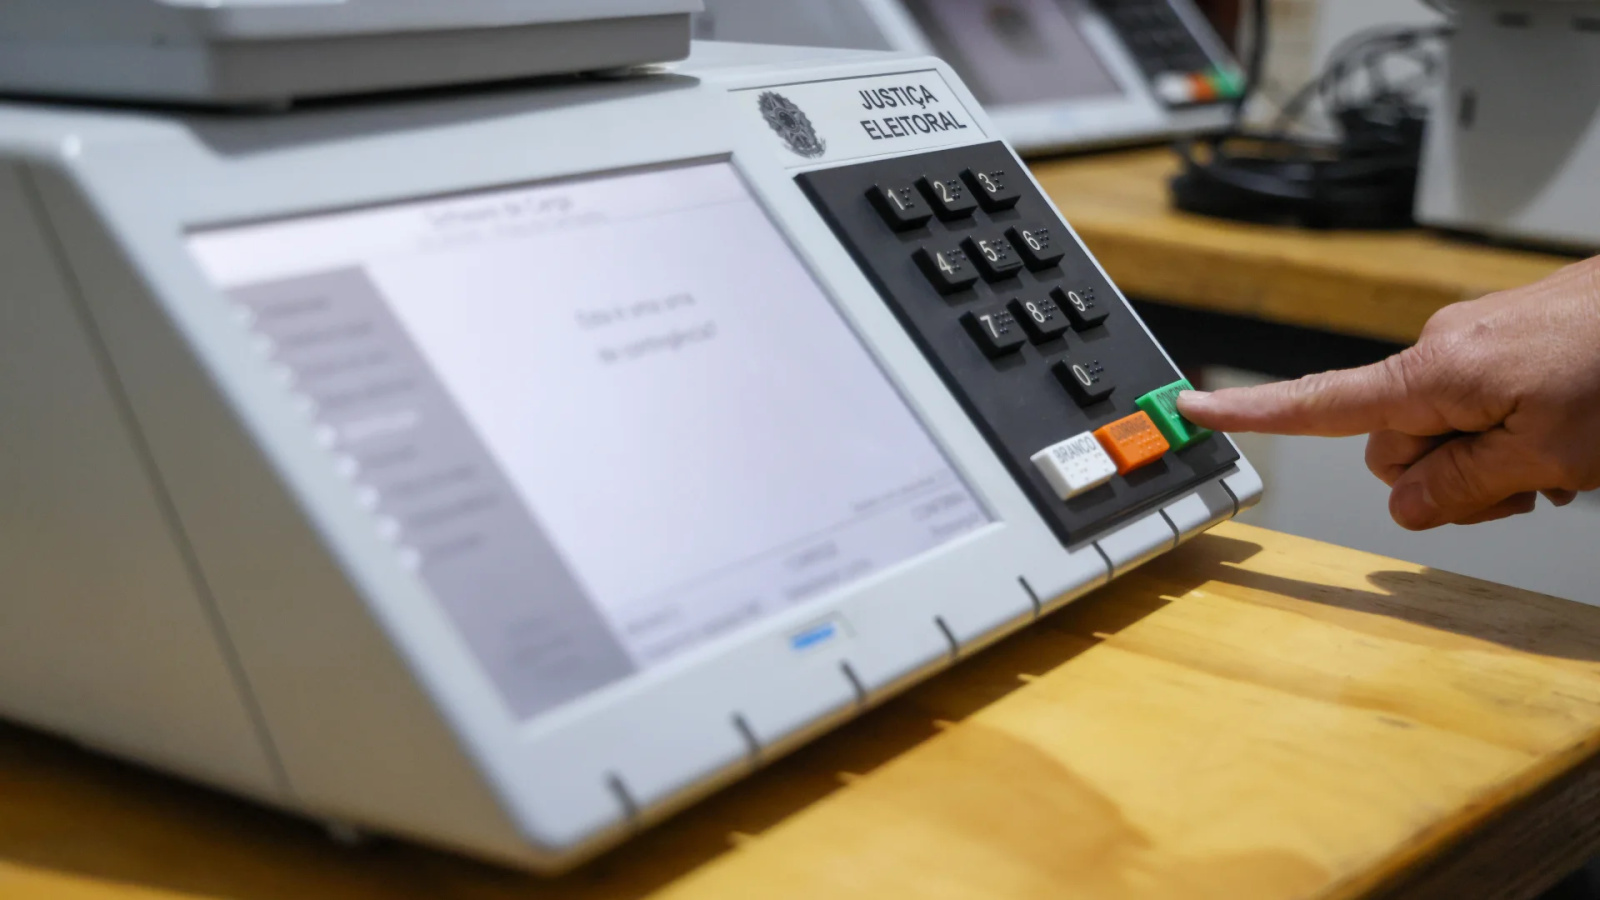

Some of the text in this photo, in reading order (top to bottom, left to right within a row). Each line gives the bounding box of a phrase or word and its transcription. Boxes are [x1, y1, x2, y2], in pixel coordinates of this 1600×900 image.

[858, 84, 939, 109] JUSTIÇA
[859, 110, 968, 140] ELEITORAL
[933, 181, 955, 203] 2
[977, 172, 997, 193] 3
[887, 188, 905, 211] 1
[978, 240, 998, 262] 5
[1022, 230, 1041, 251] 6
[936, 252, 954, 275] 4
[1025, 301, 1046, 323] 8
[1067, 290, 1086, 312] 9
[979, 314, 999, 338] 7
[1072, 364, 1092, 387] 0
[1052, 435, 1097, 464] BRANCO
